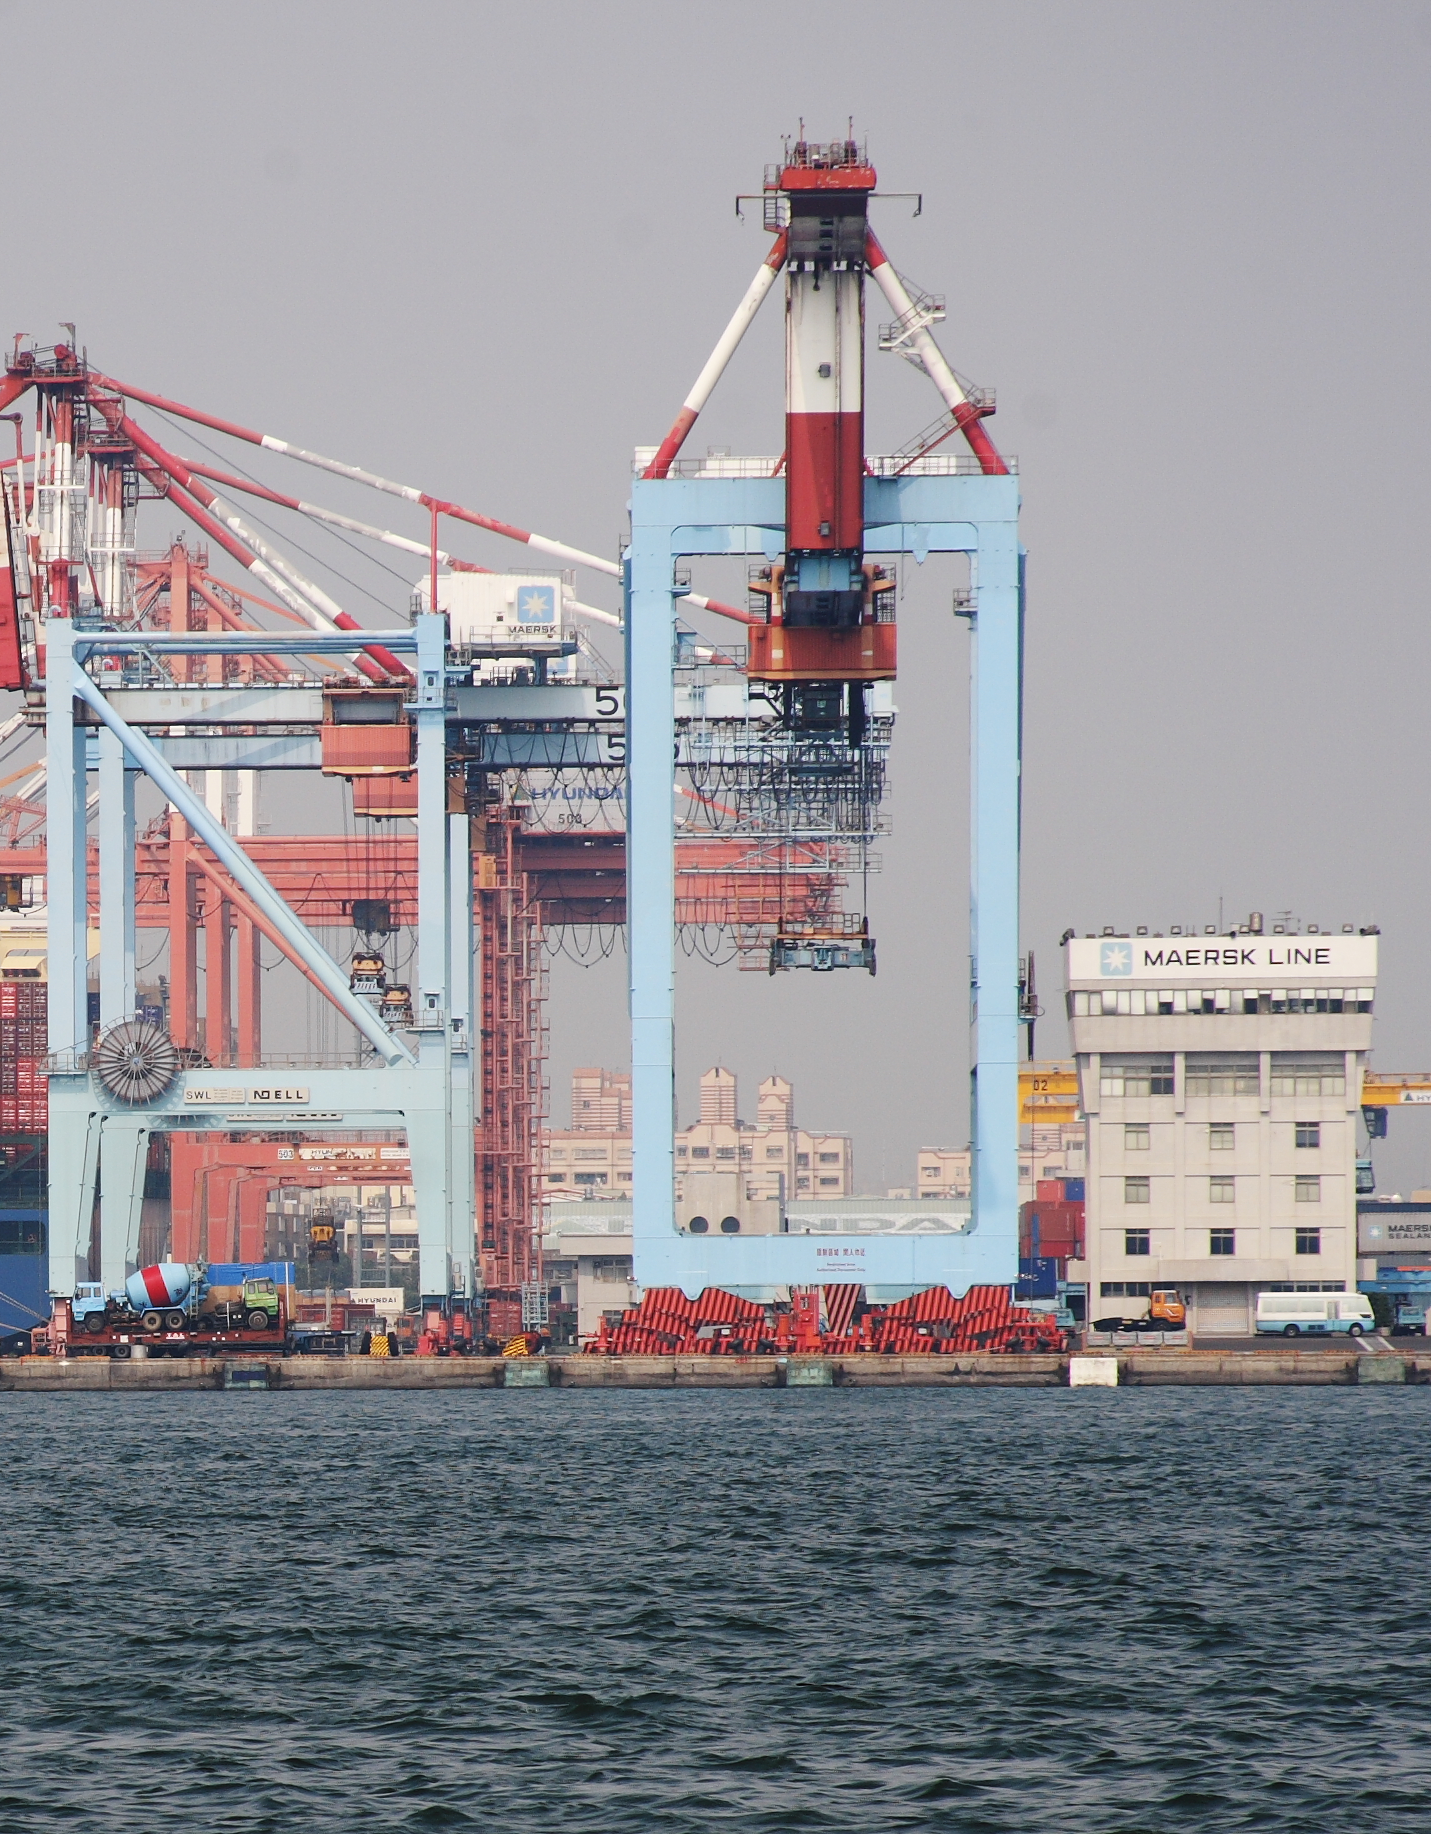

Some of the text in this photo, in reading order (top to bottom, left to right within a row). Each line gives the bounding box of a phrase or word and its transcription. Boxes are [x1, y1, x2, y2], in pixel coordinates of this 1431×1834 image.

[509, 625, 556, 634] MAERSK
[1144, 947, 1331, 966] MAERSK LINE
[186, 1091, 211, 1100] SWL
[1388, 1224, 1431, 1232] MAERS
